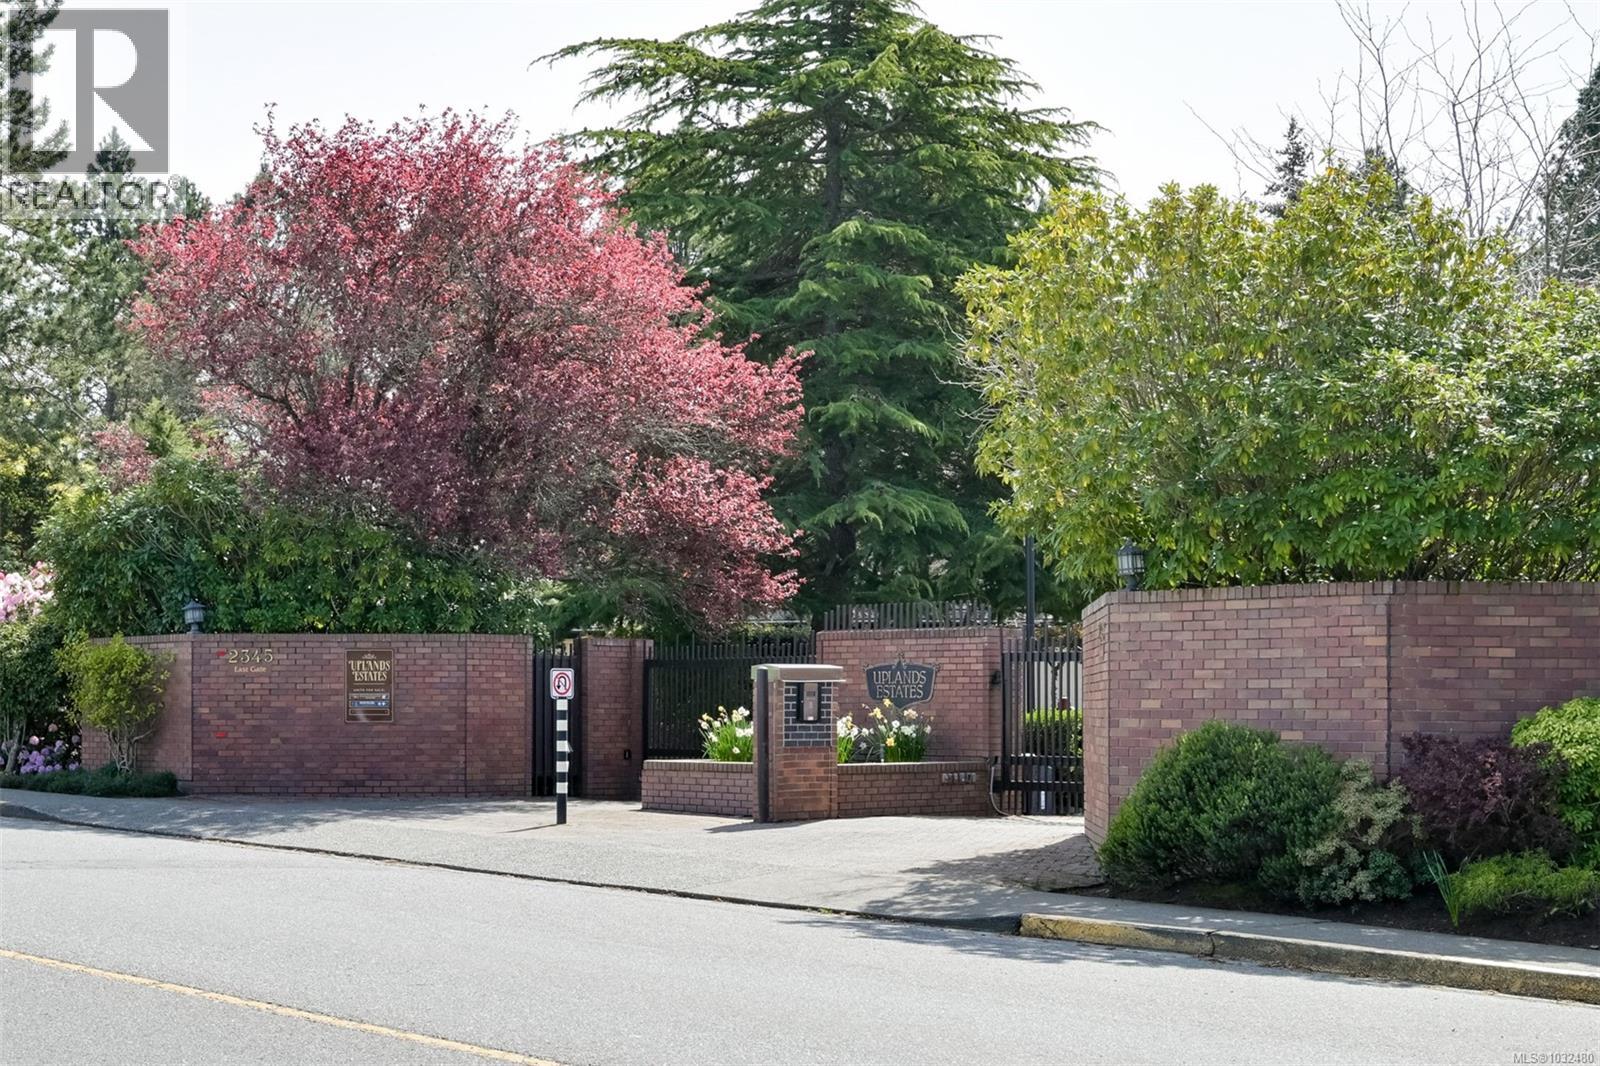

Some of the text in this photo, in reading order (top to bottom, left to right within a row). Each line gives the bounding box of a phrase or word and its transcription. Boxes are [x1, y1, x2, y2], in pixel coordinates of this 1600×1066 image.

[228, 649, 274, 664] 2345
[348, 660, 391, 671] UPLANDS
[351, 671, 388, 681] ESTATES
[873, 670, 927, 684] UPLANDS
[876, 685, 924, 698] ESTATES
